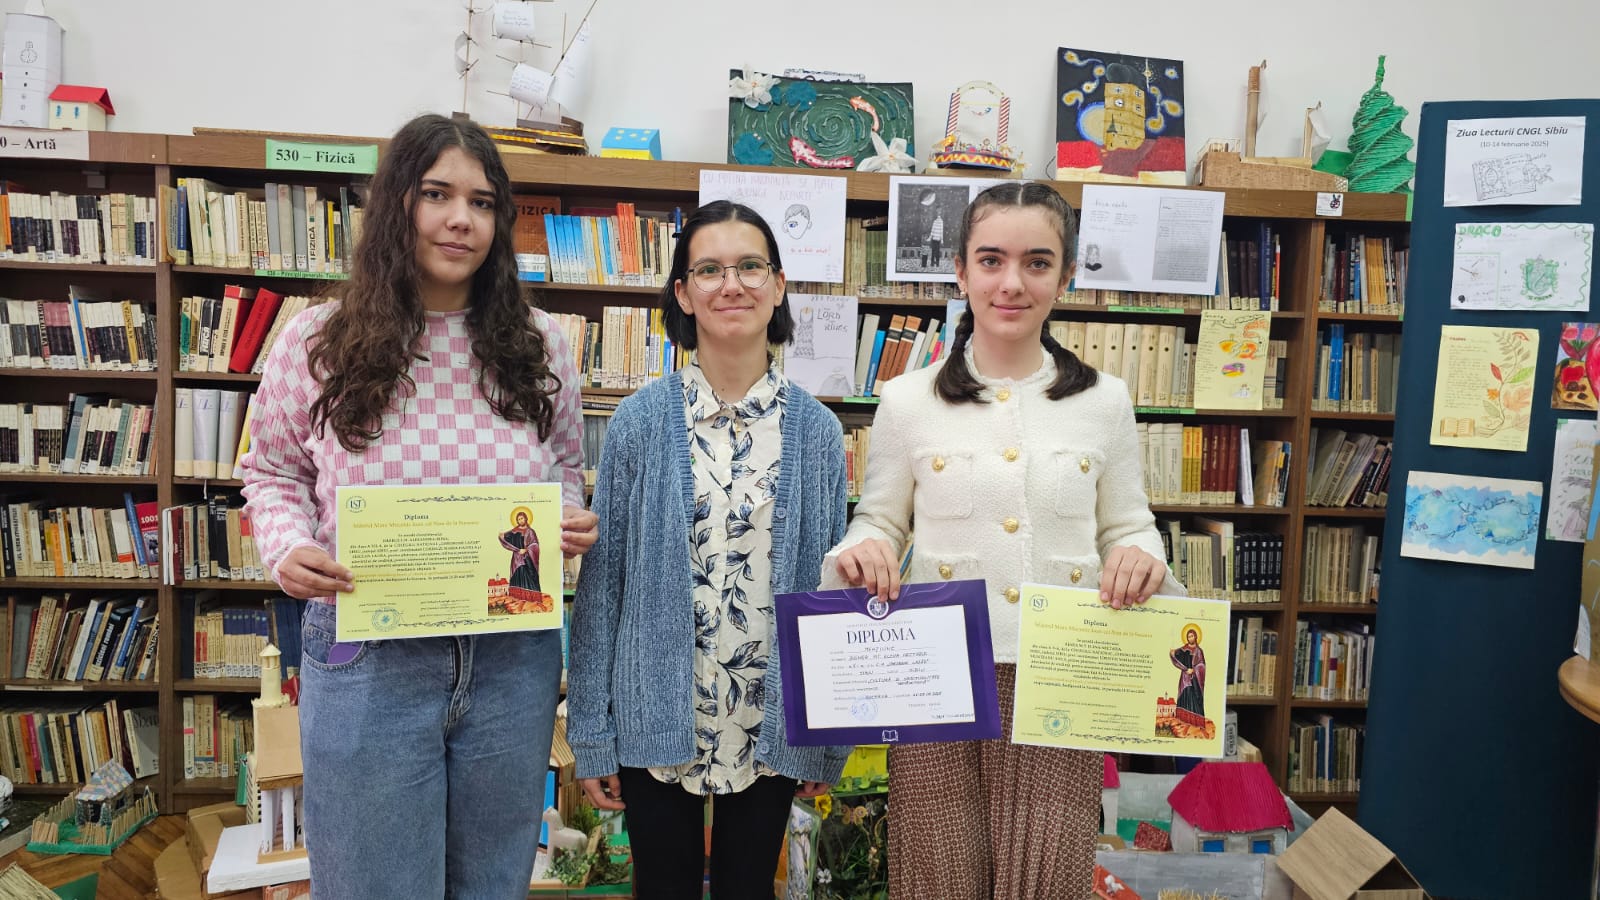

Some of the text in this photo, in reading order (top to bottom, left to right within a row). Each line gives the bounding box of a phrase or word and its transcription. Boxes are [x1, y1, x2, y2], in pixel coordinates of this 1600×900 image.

[1456, 126, 1568, 138] Ziua Lecturii CNGL Sibiu
[25, 136, 57, 150] Artă
[1501, 140, 1530, 148] februarie
[275, 149, 300, 162] 530
[315, 150, 356, 165] Fizică
[1458, 225, 1502, 237] DRACO
[403, 513, 430, 524] Diploma
[1083, 618, 1108, 629] Diploma
[846, 627, 917, 644] DIPLOMA
